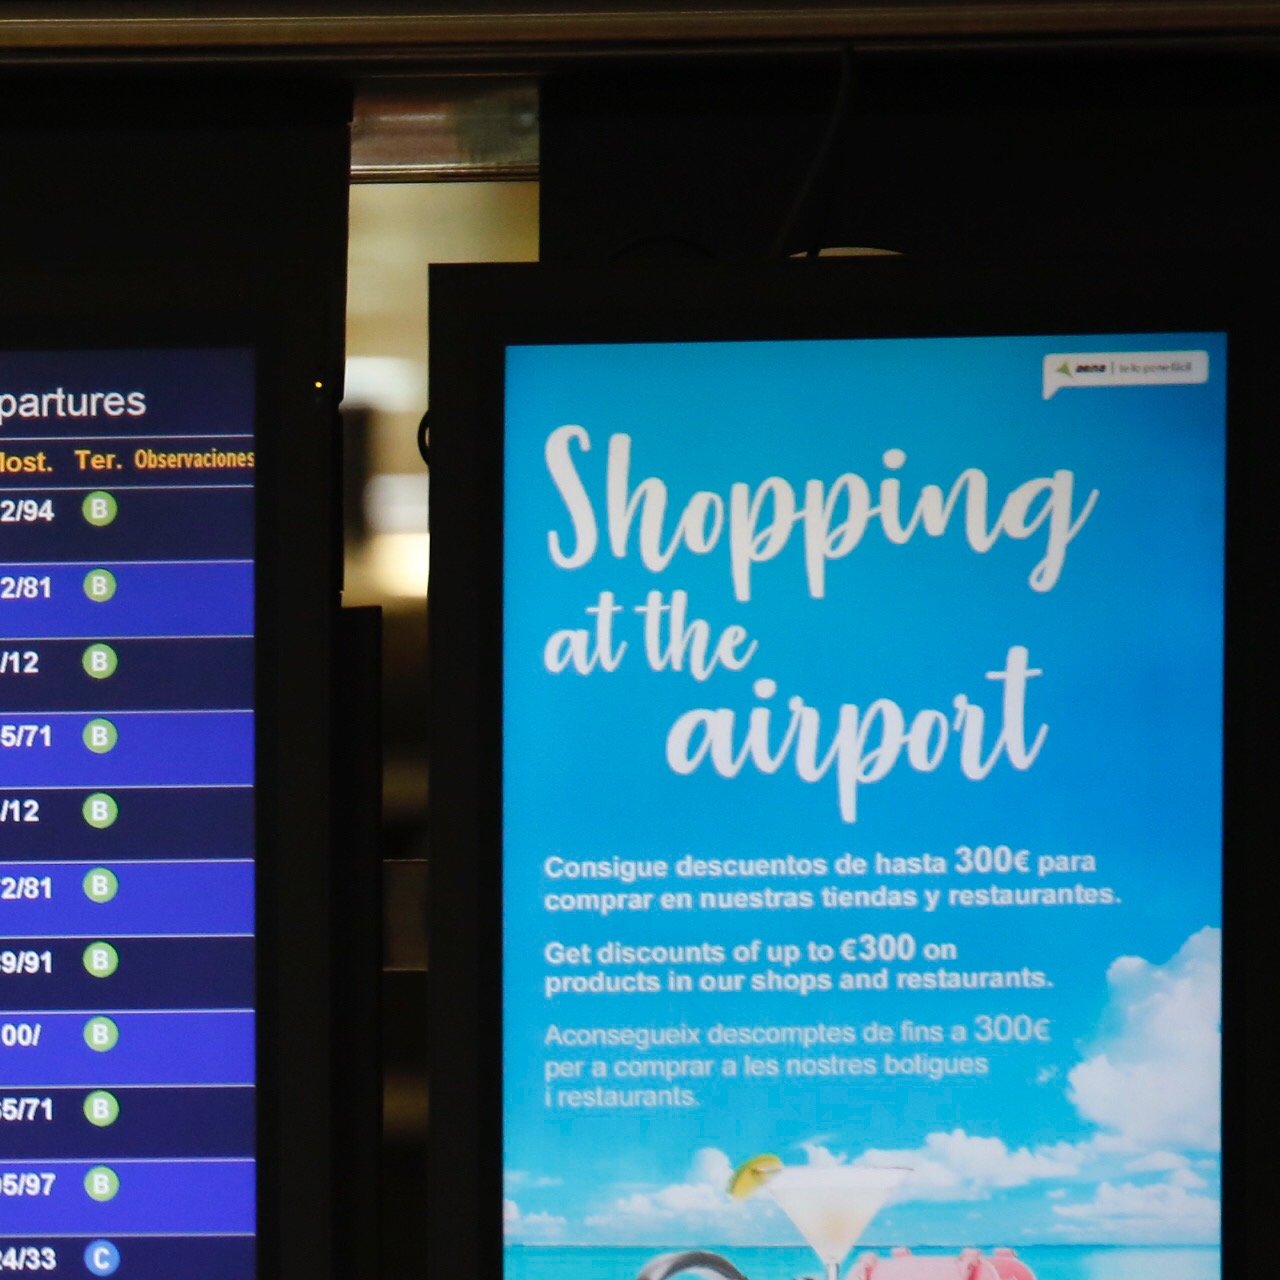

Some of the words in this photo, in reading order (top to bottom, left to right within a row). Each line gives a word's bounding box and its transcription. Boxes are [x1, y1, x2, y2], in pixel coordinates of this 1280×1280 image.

[74, 449, 123, 471] Ter.
[134, 447, 255, 470] Observaciones
[544, 424, 1099, 601] Shopping
[92, 575, 108, 596] B
[543, 591, 627, 676] at
[634, 589, 758, 681] the
[91, 725, 108, 746] B
[666, 645, 1049, 824] airport
[543, 855, 669, 884] Consigue
[674, 854, 829, 879] descuentos
[833, 852, 869, 877] de
[874, 851, 948, 876] hasta
[954, 844, 1031, 875] 300€
[1037, 854, 1097, 878] para
[543, 891, 655, 916] comprar
[658, 892, 694, 911] en
[698, 887, 815, 911] nuestras
[820, 885, 919, 909] tiendas
[923, 888, 941, 913] y
[948, 883, 1122, 907] restaurantes.
[543, 941, 594, 966] Get
[595, 941, 727, 965] discounts
[732, 939, 762, 964] of
[766, 944, 802, 968] up
[806, 941, 835, 963] to
[839, 932, 917, 962] €300
[922, 943, 958, 961] on
[544, 970, 662, 999] products
[667, 970, 694, 993] in
[698, 974, 746, 993] our
[750, 969, 833, 997] shops
[838, 967, 889, 992] and
[896, 967, 1054, 990] restaurants.
[543, 1023, 701, 1051] Aconsegueix
[706, 1023, 857, 1049] descomptes
[861, 1021, 895, 1045] de
[900, 1019, 945, 1044] fins
[949, 1024, 968, 1044] a
[974, 1013, 1051, 1043] 300€
[544, 1059, 585, 1084] per
[590, 1060, 609, 1080] a
[613, 1059, 715, 1082] comprar
[721, 1058, 738, 1078] a
[743, 1054, 781, 1078] les
[784, 1056, 878, 1077] nostres
[883, 1053, 989, 1081] botigues
[544, 1086, 552, 1107] i
[557, 1086, 699, 1109] restaurants.
